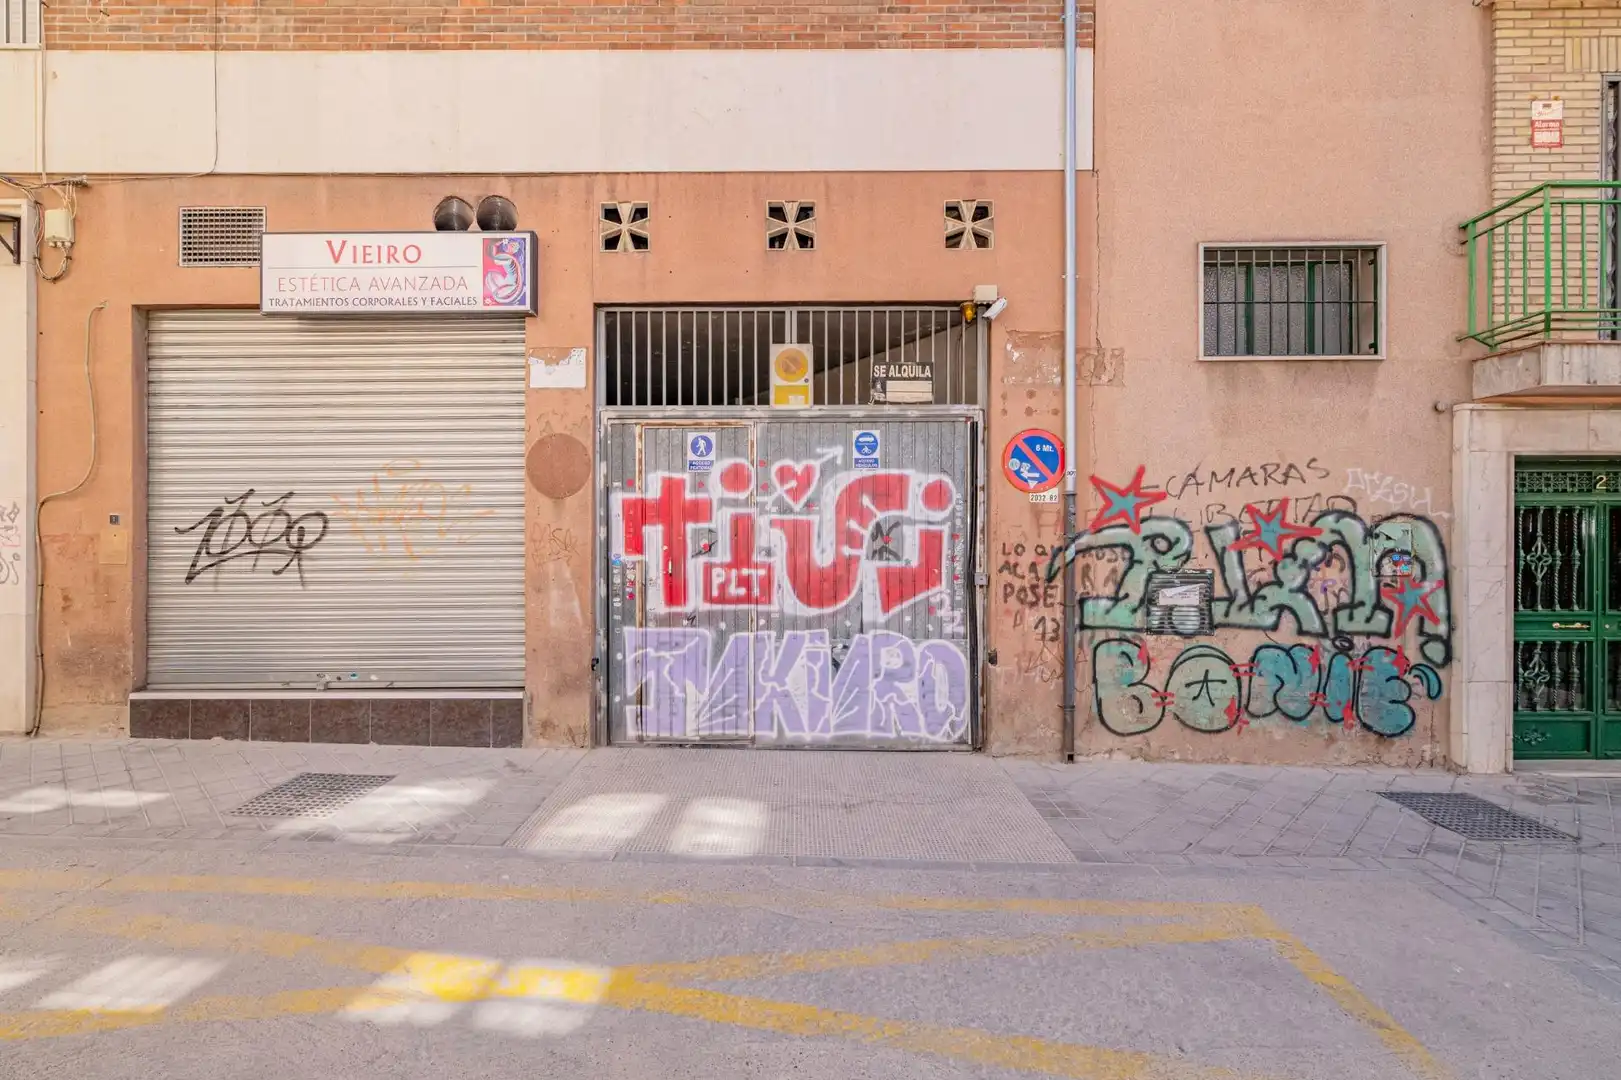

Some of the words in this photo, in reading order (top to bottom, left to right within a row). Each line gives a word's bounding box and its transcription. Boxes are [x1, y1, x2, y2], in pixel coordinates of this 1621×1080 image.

[278, 274, 361, 293] ESTÉTICA
[368, 276, 468, 292] AVANZADA
[269, 298, 349, 307] TRATAMIENTOS
[352, 297, 418, 307] CORPORALES
[421, 297, 428, 307] Y
[430, 297, 477, 306] FACIALES
[873, 364, 887, 378] SE
[888, 364, 932, 378] ALQUILA
[1596, 474, 1607, 489] 2
